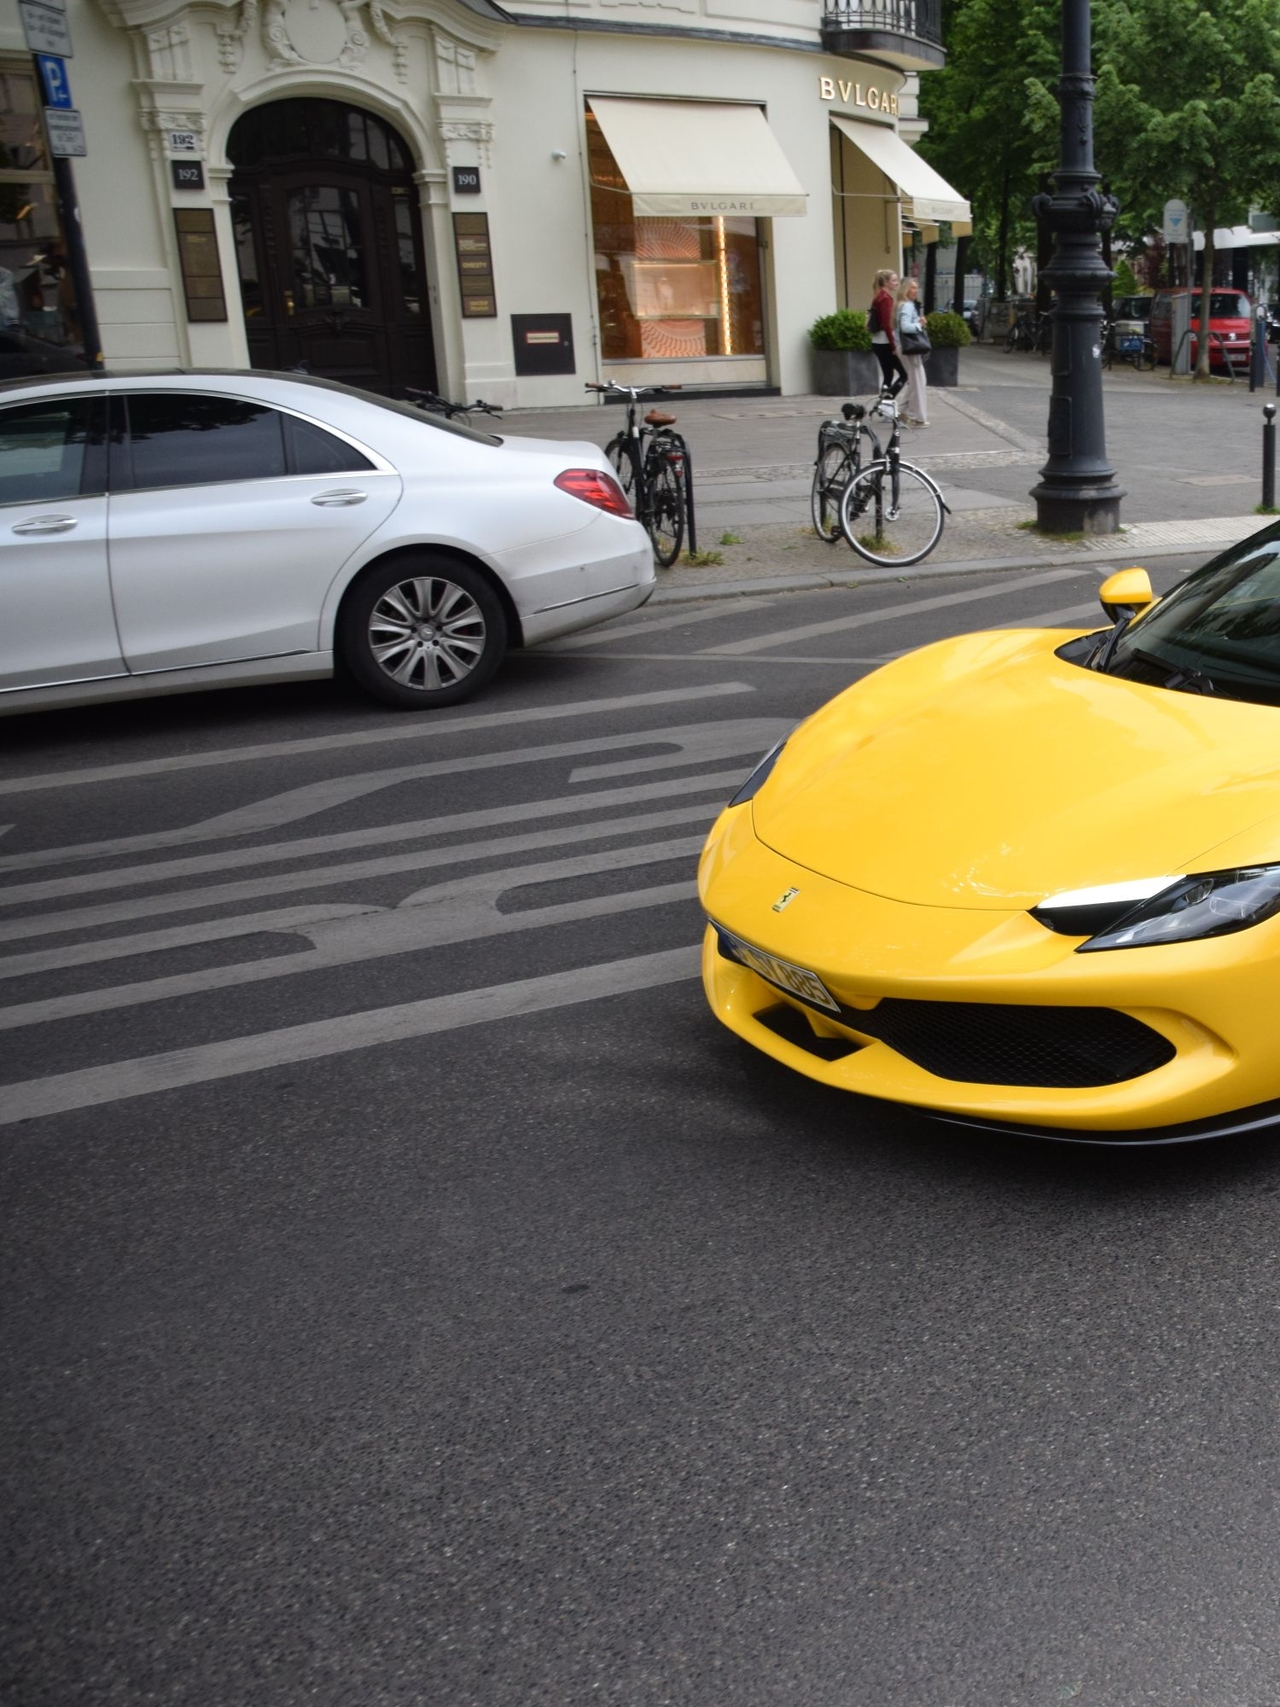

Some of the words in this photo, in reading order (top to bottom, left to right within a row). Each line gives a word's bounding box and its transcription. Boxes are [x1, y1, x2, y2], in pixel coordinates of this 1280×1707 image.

[172, 134, 194, 145] 192
[178, 169, 199, 180] 192
[458, 174, 477, 185] 190
[691, 202, 755, 211] BVLGARI
